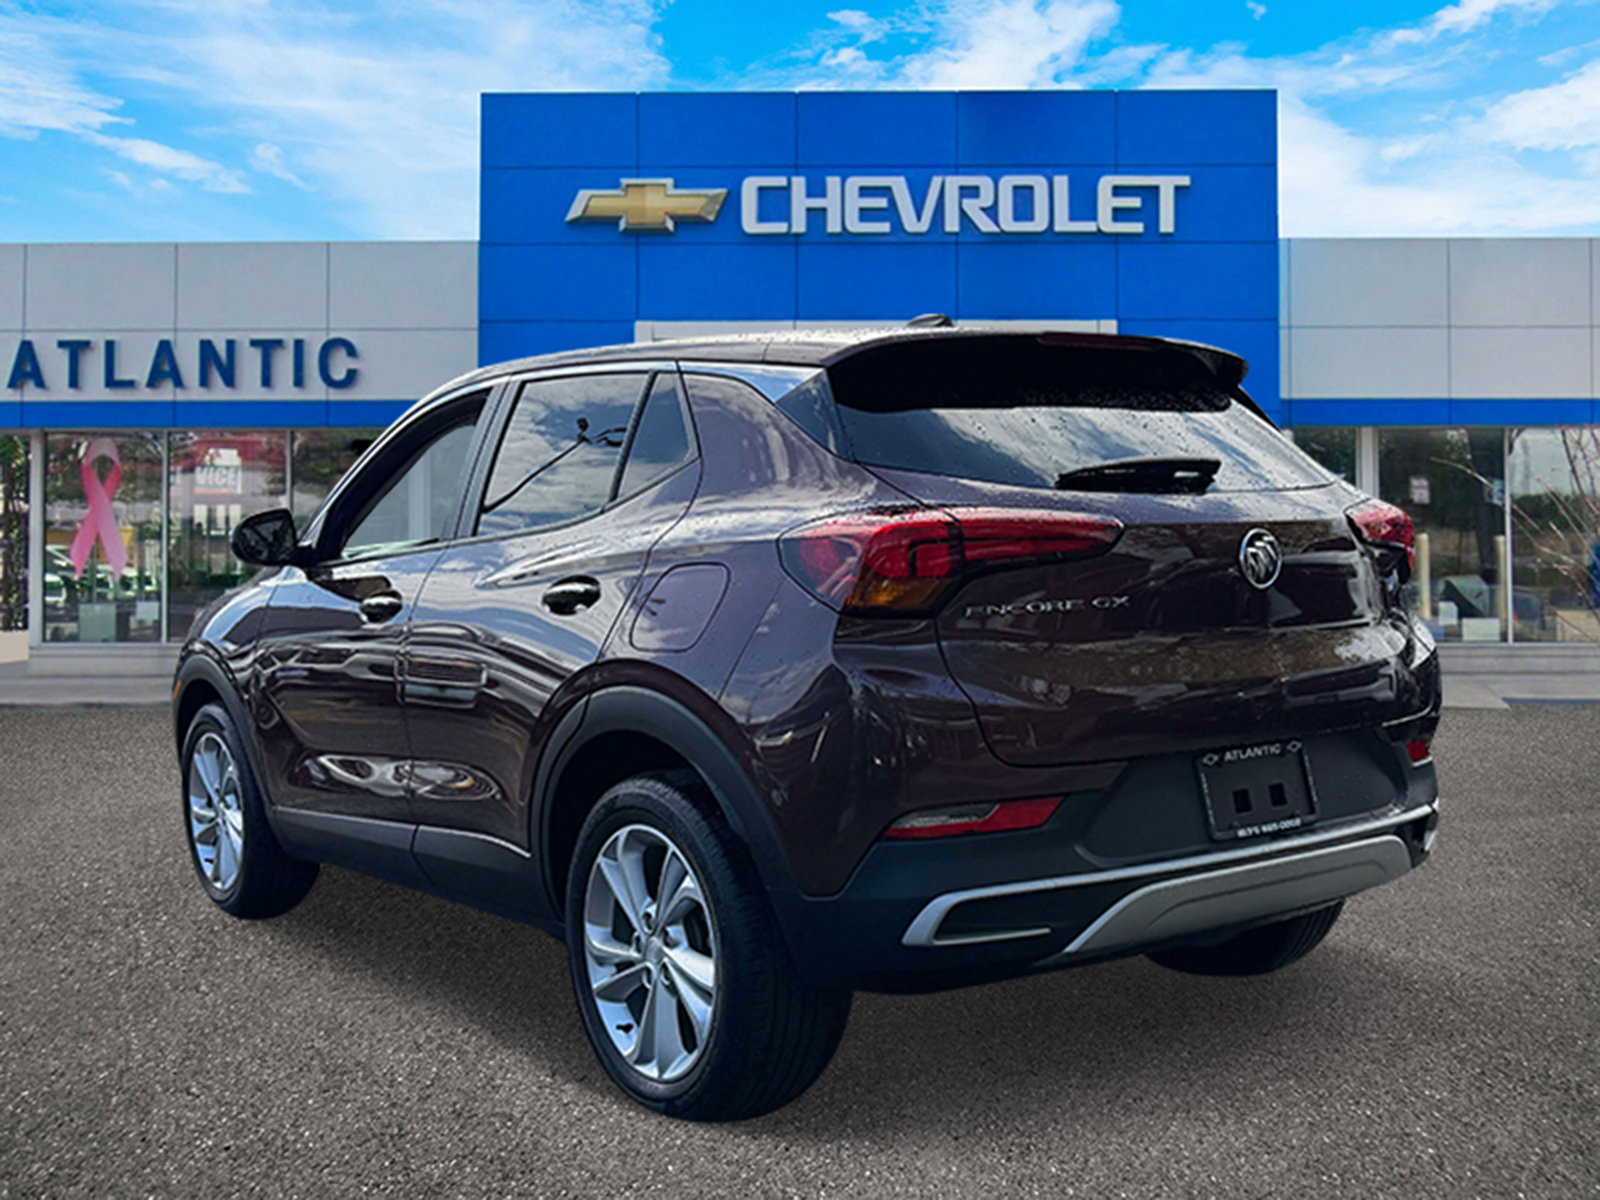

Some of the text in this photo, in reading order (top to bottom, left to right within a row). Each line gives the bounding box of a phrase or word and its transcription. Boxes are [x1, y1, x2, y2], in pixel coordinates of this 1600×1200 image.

[740, 173, 1192, 236] CHEVROLET
[7, 336, 361, 390] ATLANTIC
[964, 594, 1130, 618] ENCORE GX
[1224, 743, 1281, 762] ATLANTIC
